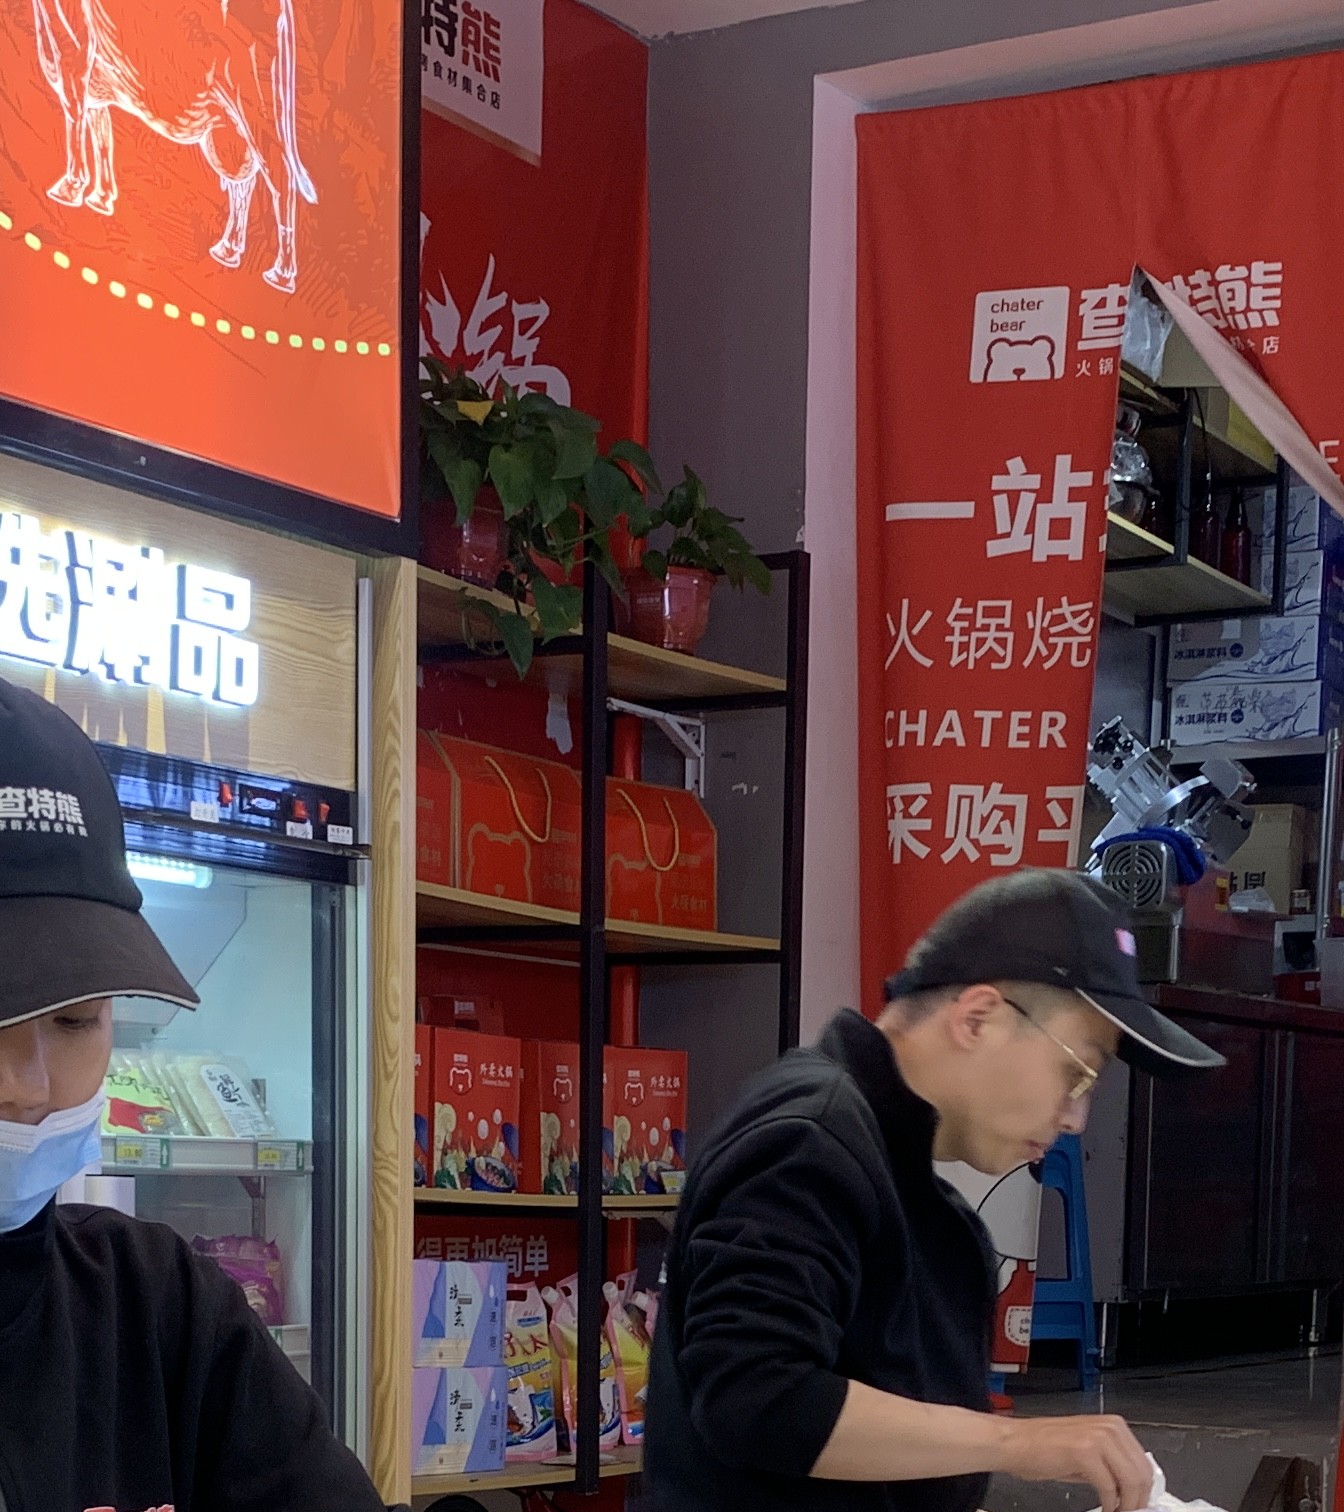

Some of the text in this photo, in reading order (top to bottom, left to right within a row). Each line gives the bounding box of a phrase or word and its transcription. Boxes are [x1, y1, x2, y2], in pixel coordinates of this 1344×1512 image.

[990, 296, 1045, 314] chater
[990, 318, 1027, 334] bear
[884, 597, 1096, 671] 火锅烧
[884, 711, 1067, 749] CHATER
